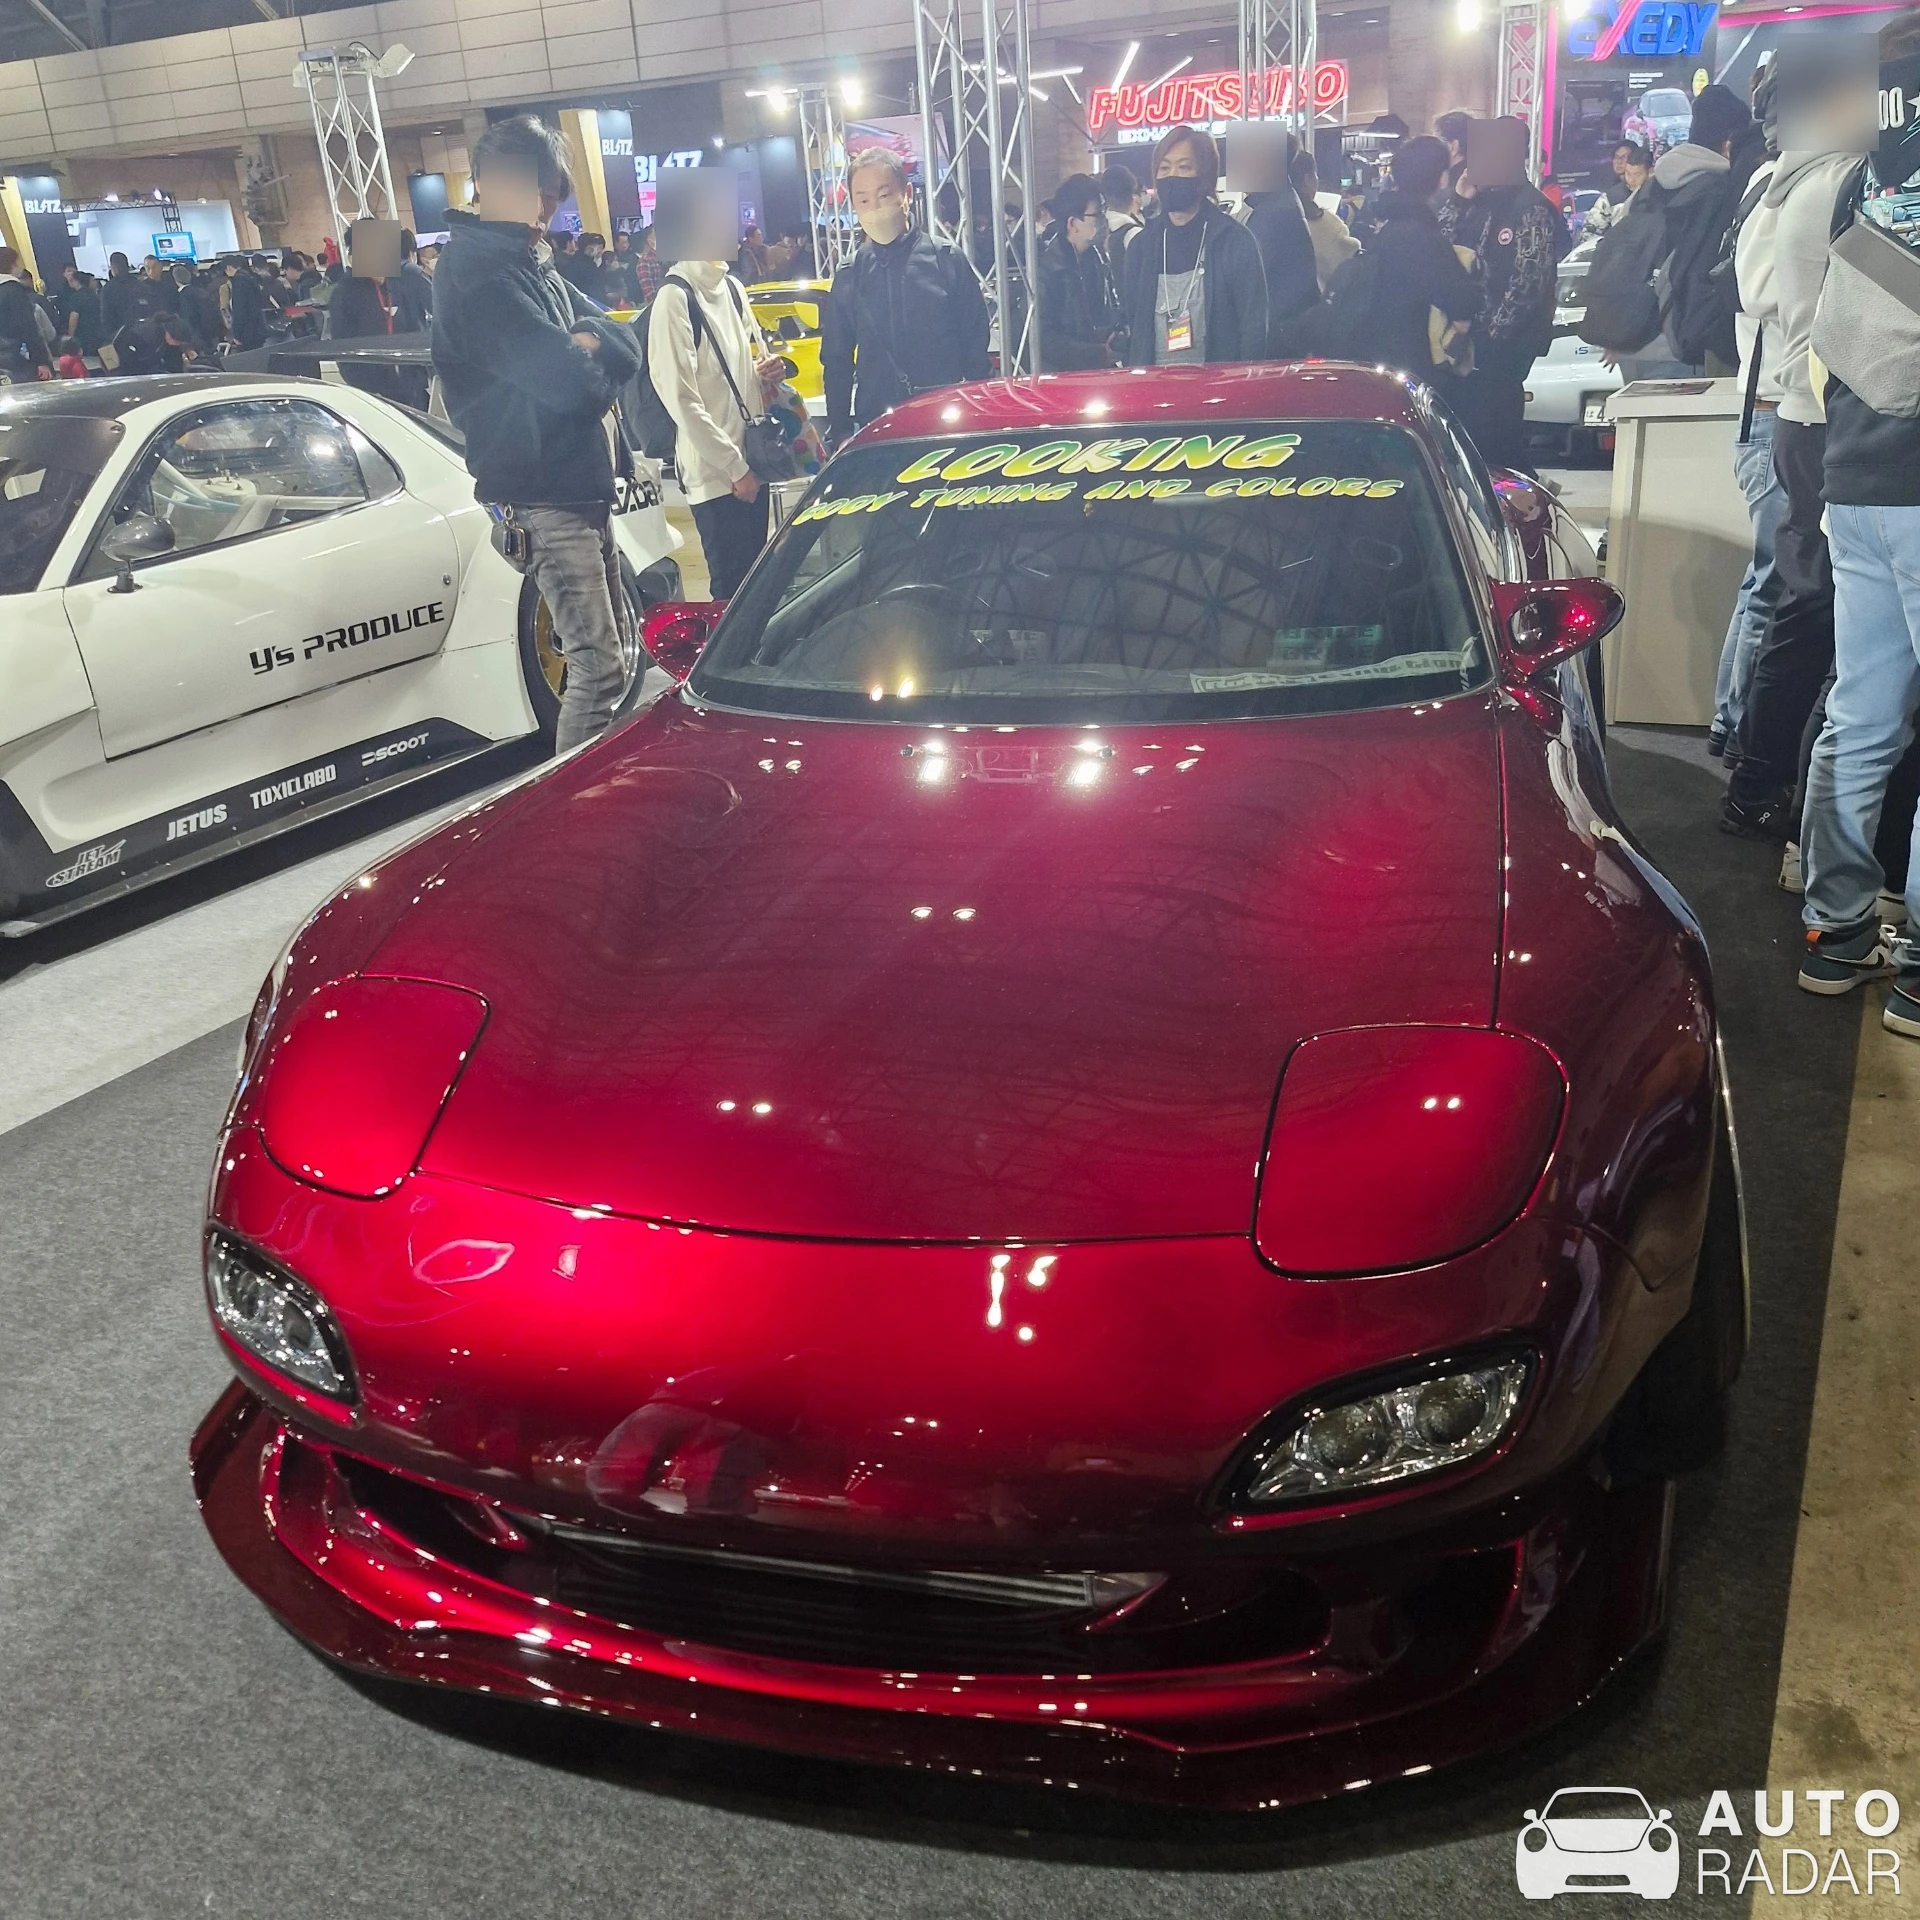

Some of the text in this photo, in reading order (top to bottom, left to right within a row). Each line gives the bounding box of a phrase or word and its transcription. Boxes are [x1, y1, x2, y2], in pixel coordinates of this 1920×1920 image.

[601, 138, 633, 156] BLITZ
[24, 198, 62, 214] BLITZ
[896, 434, 1302, 483] LOOKING
[791, 490, 908, 526] BODY
[910, 481, 1078, 508] TUNING
[1083, 479, 1192, 500] AND
[1204, 476, 1404, 498] COLORS
[302, 601, 445, 660] PRODUCE
[249, 764, 337, 810] TOXICLABO
[166, 803, 228, 842] JETUS
[51, 849, 121, 886] STREAM
[75, 844, 106, 867] JET
